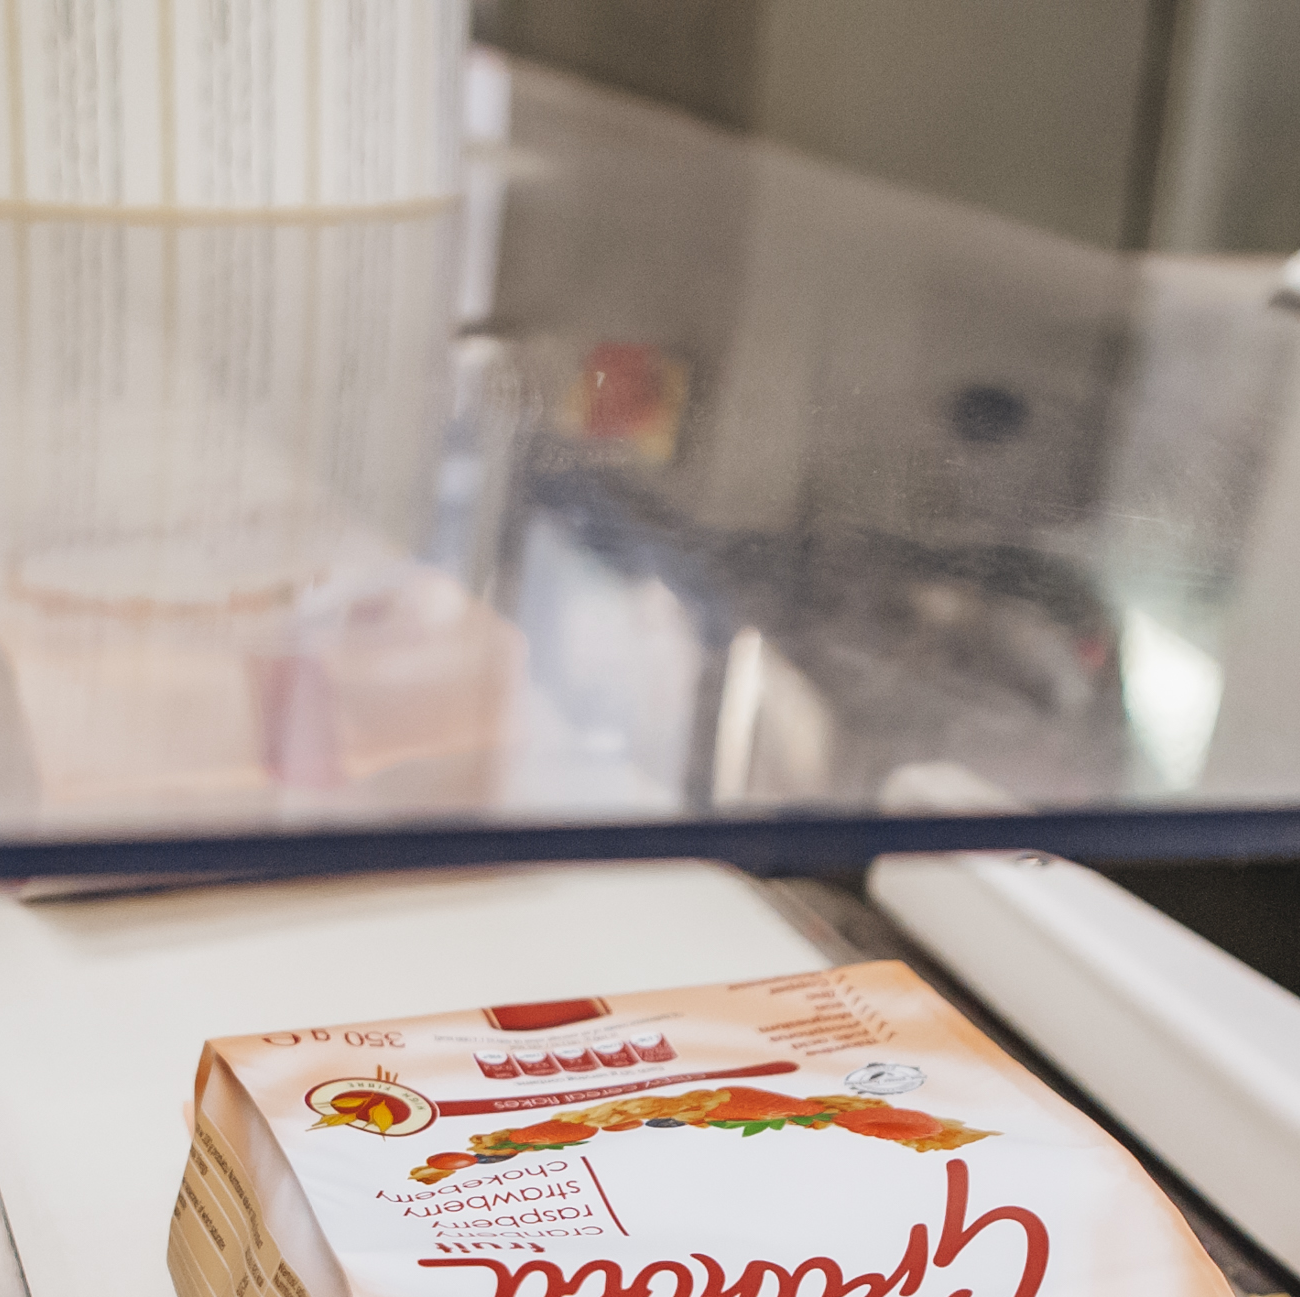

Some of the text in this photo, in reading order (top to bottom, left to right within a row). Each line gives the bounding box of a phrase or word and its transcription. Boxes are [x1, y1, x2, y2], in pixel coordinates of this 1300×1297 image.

[310, 1029, 405, 1048] 350 g
[492, 1095, 560, 1109] flakes
[564, 1084, 637, 1105] cereal
[375, 1160, 569, 1203] chokeberry
[403, 1180, 581, 1218] strawberry
[432, 1204, 594, 1229] raspberry
[435, 1226, 604, 1239] cranberry
[434, 1242, 545, 1253] fruit
